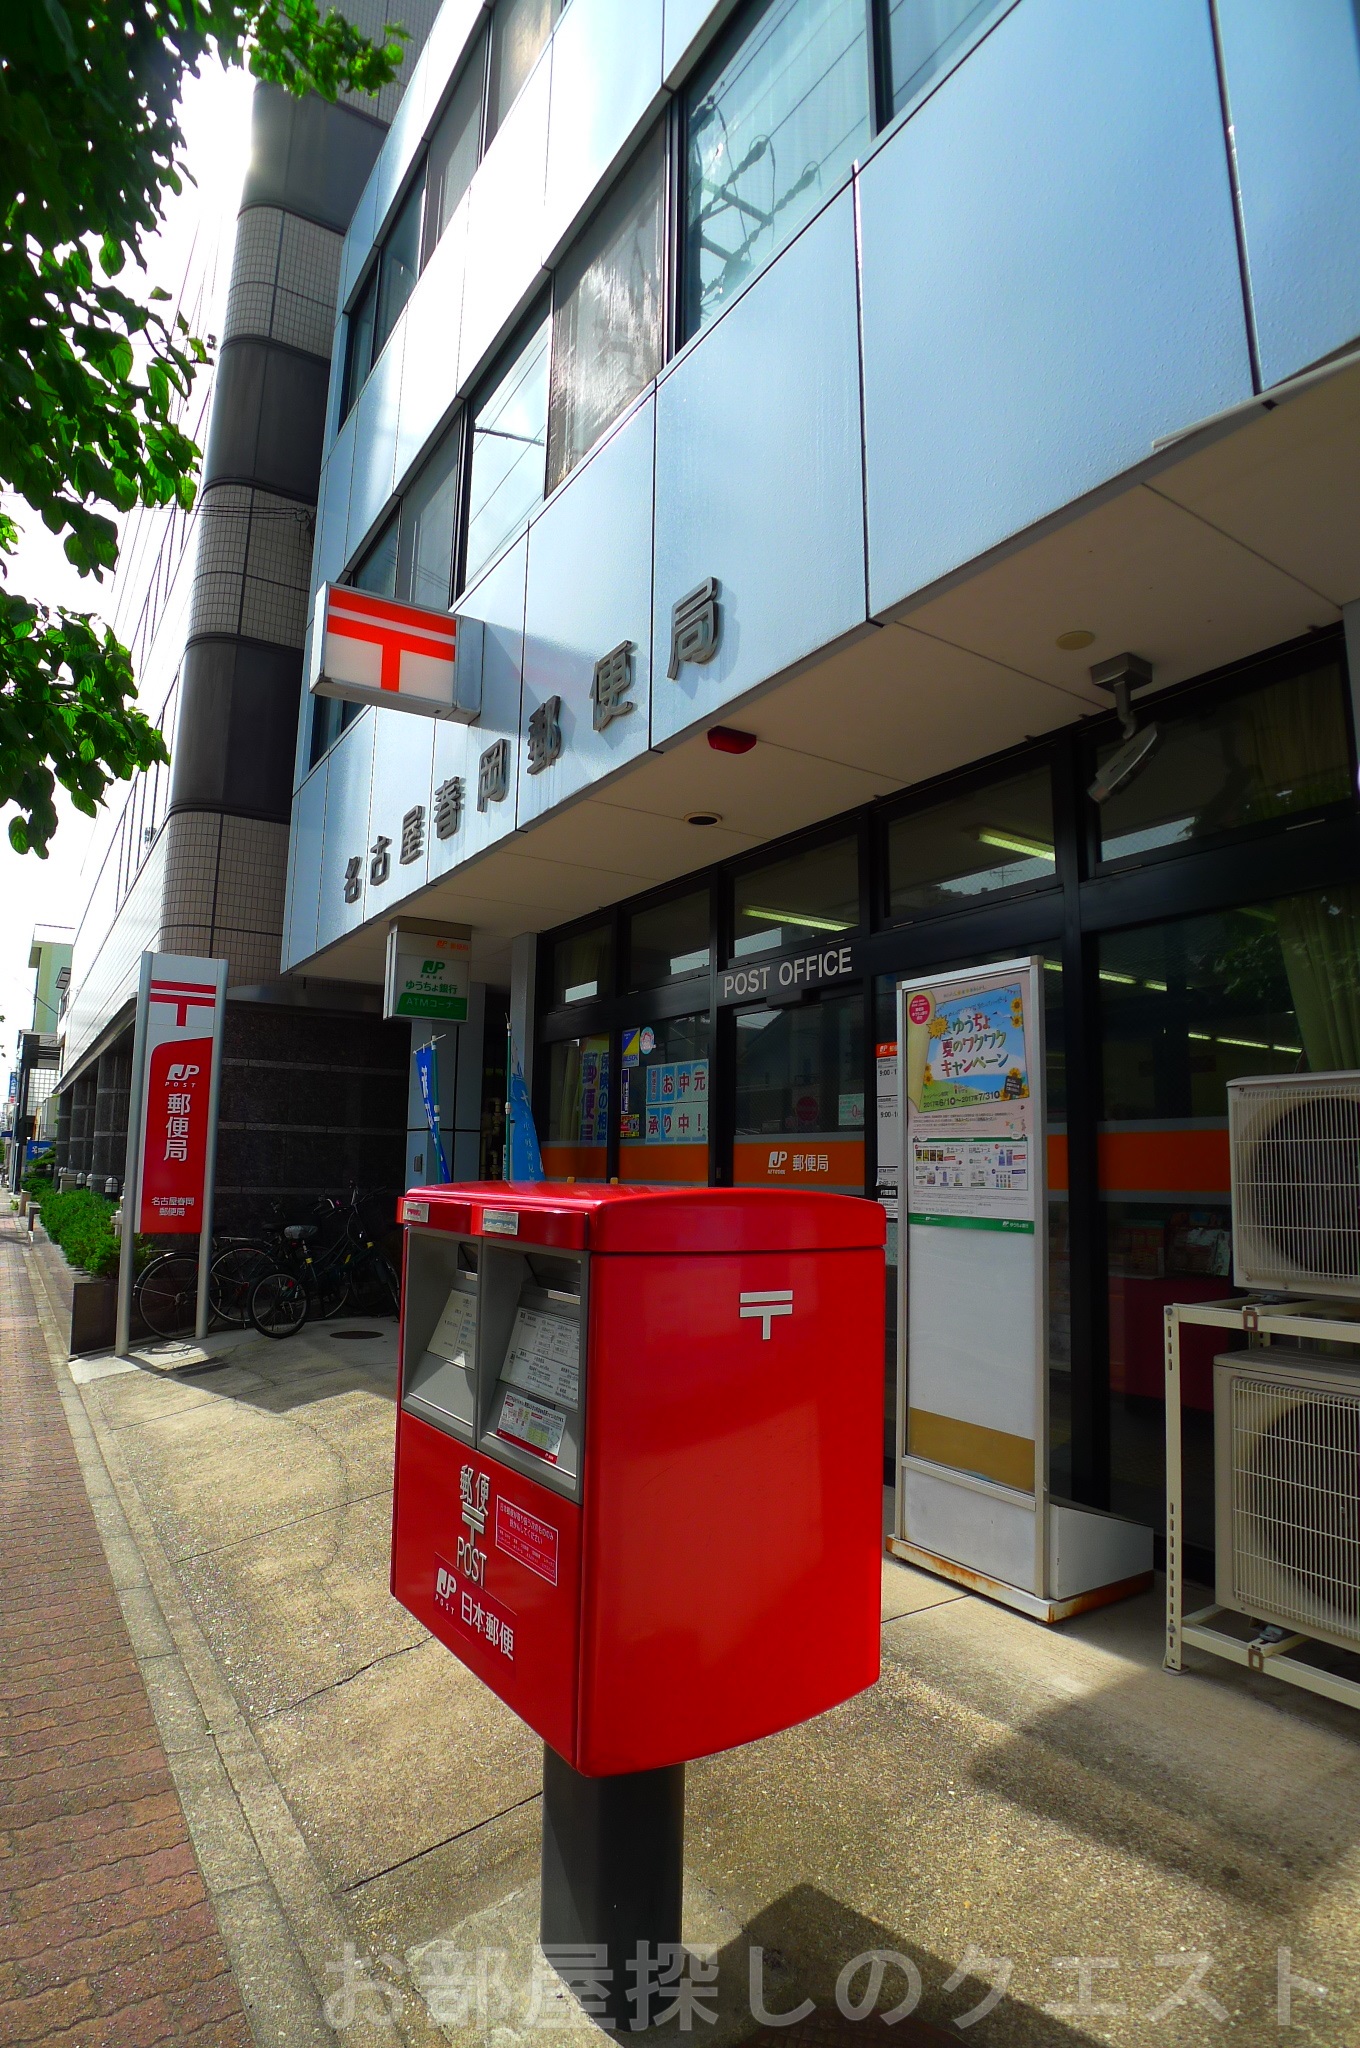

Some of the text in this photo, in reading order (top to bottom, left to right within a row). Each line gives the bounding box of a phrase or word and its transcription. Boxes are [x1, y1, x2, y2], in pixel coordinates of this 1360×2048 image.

[724, 947, 852, 998] POST OFFICE
[405, 980, 458, 995] ゆうちょ銀行
[406, 997, 461, 1009] ATMコーナー
[953, 1012, 991, 1035] ゆうちょ
[941, 1029, 1007, 1058] 夏のワクワク
[166, 1063, 199, 1081] JP
[941, 1053, 1009, 1077] キャンペーン
[662, 1071, 706, 1094] お中元
[163, 1093, 191, 1162] 郵便局
[767, 1151, 788, 1168] JP
[792, 1154, 829, 1172] 郵便局
[459, 1463, 491, 1517] 郵便
[456, 1536, 488, 1588] POST
[435, 1567, 457, 1600] JP
[434, 1594, 456, 1615] POST
[460, 1590, 515, 1661] 日本郵便
